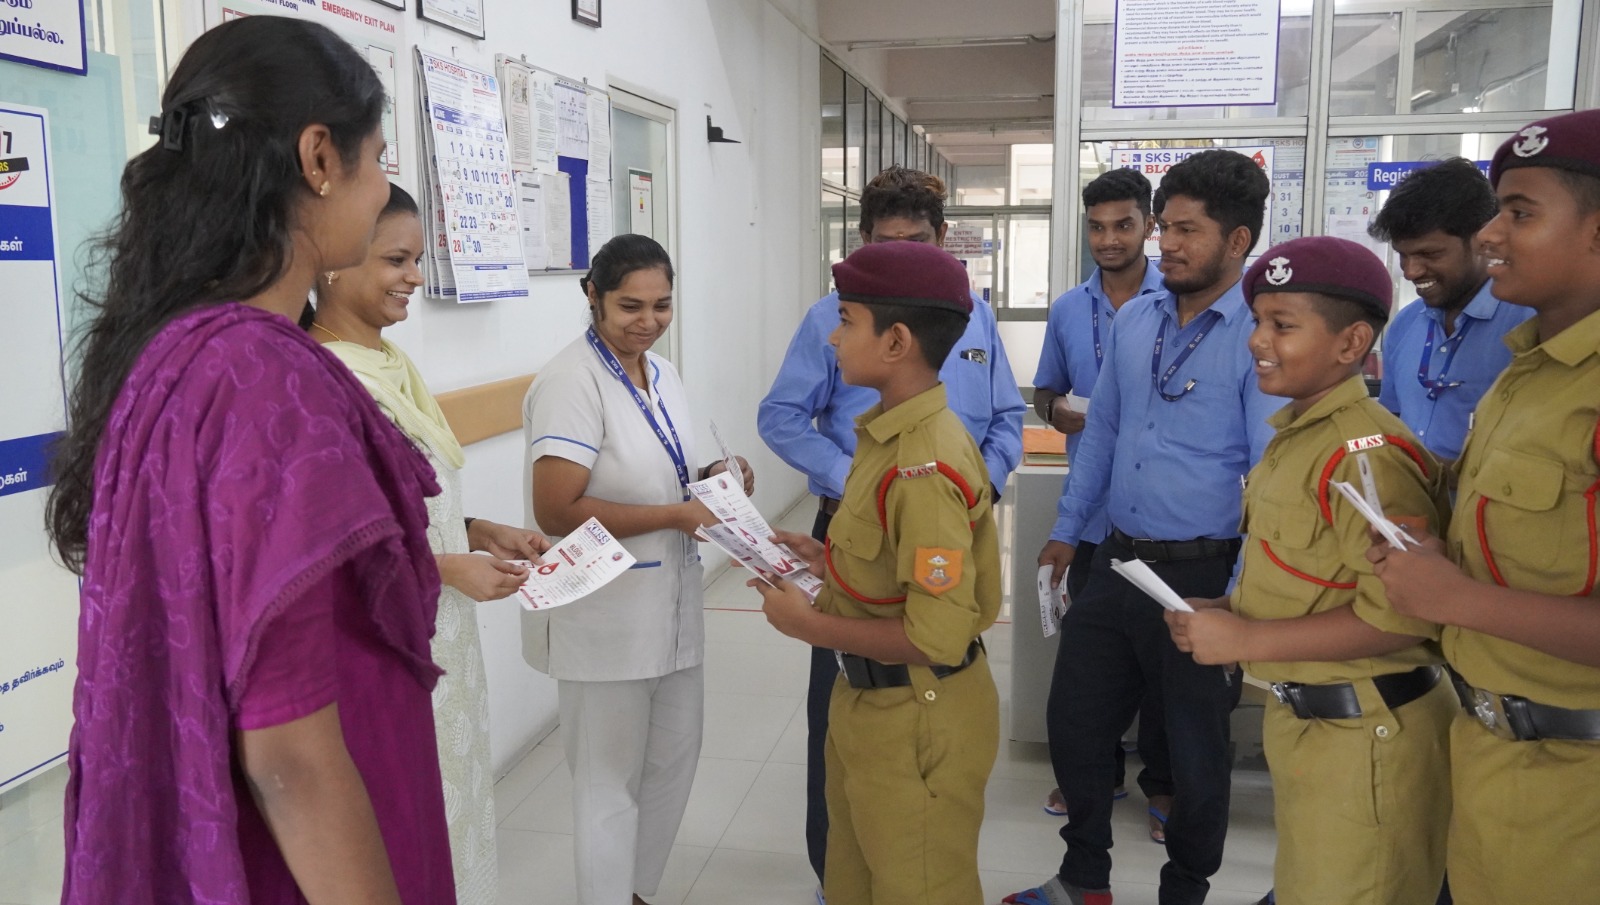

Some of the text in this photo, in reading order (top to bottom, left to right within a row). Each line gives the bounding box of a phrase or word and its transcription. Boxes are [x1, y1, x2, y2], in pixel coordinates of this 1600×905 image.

[322, 1, 363, 22] EMERGENCY
[364, 15, 378, 28] EXIT
[380, 20, 395, 33] PLAN
[433, 60, 467, 79] SKS HOSPITAL
[1275, 139, 1291, 147] SKS
[451, 141, 504, 162] 1 2 3 4 5 6
[1145, 152, 1171, 163] SKS
[463, 168, 509, 186] 9 10 11 12 13
[465, 193, 473, 205] 16
[475, 194, 482, 206] 17
[505, 196, 512, 208] 20
[1281, 192, 1291, 201] 31
[1282, 208, 1288, 217] 3
[1329, 206, 1368, 215] 6 7 8
[460, 216, 468, 228] 22
[469, 216, 477, 229] 23
[1279, 225, 1290, 233] 10
[438, 234, 446, 247] 25
[473, 241, 481, 253] 30
[1346, 434, 1384, 453] KMSS
[899, 465, 936, 479] KMSS
[587, 522, 610, 545] KMSS
